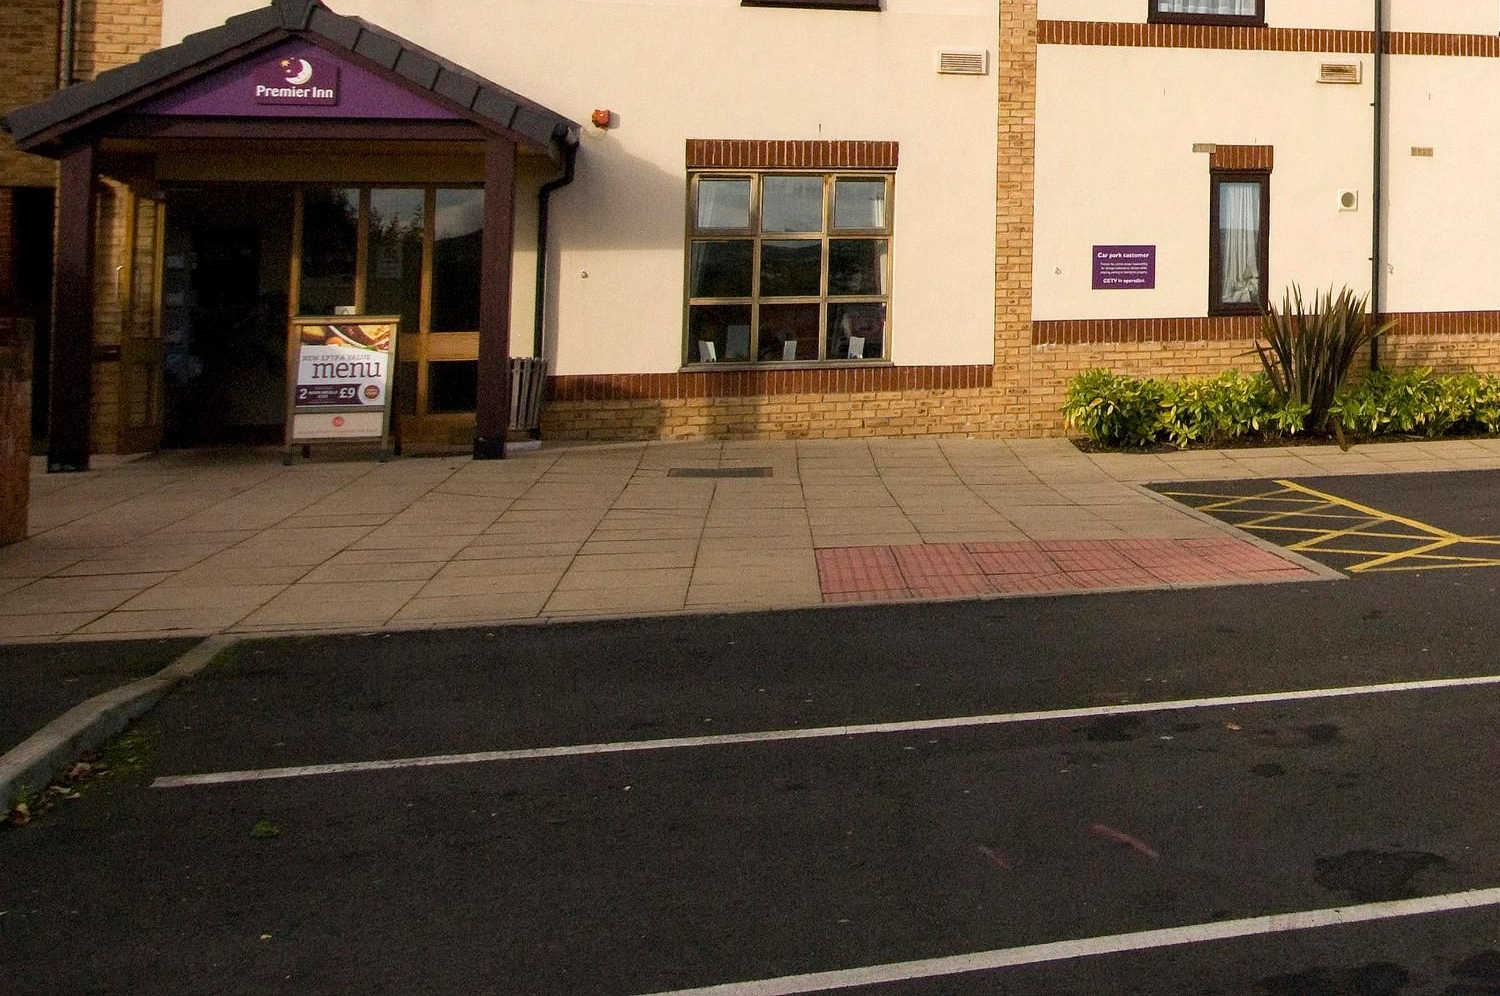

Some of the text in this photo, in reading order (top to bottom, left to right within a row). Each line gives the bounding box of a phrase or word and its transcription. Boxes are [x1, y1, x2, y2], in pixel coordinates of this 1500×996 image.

[256, 85, 334, 98] Premier Inn
[312, 361, 381, 379] menu
[299, 388, 308, 399] 2
[339, 388, 356, 399] £9
